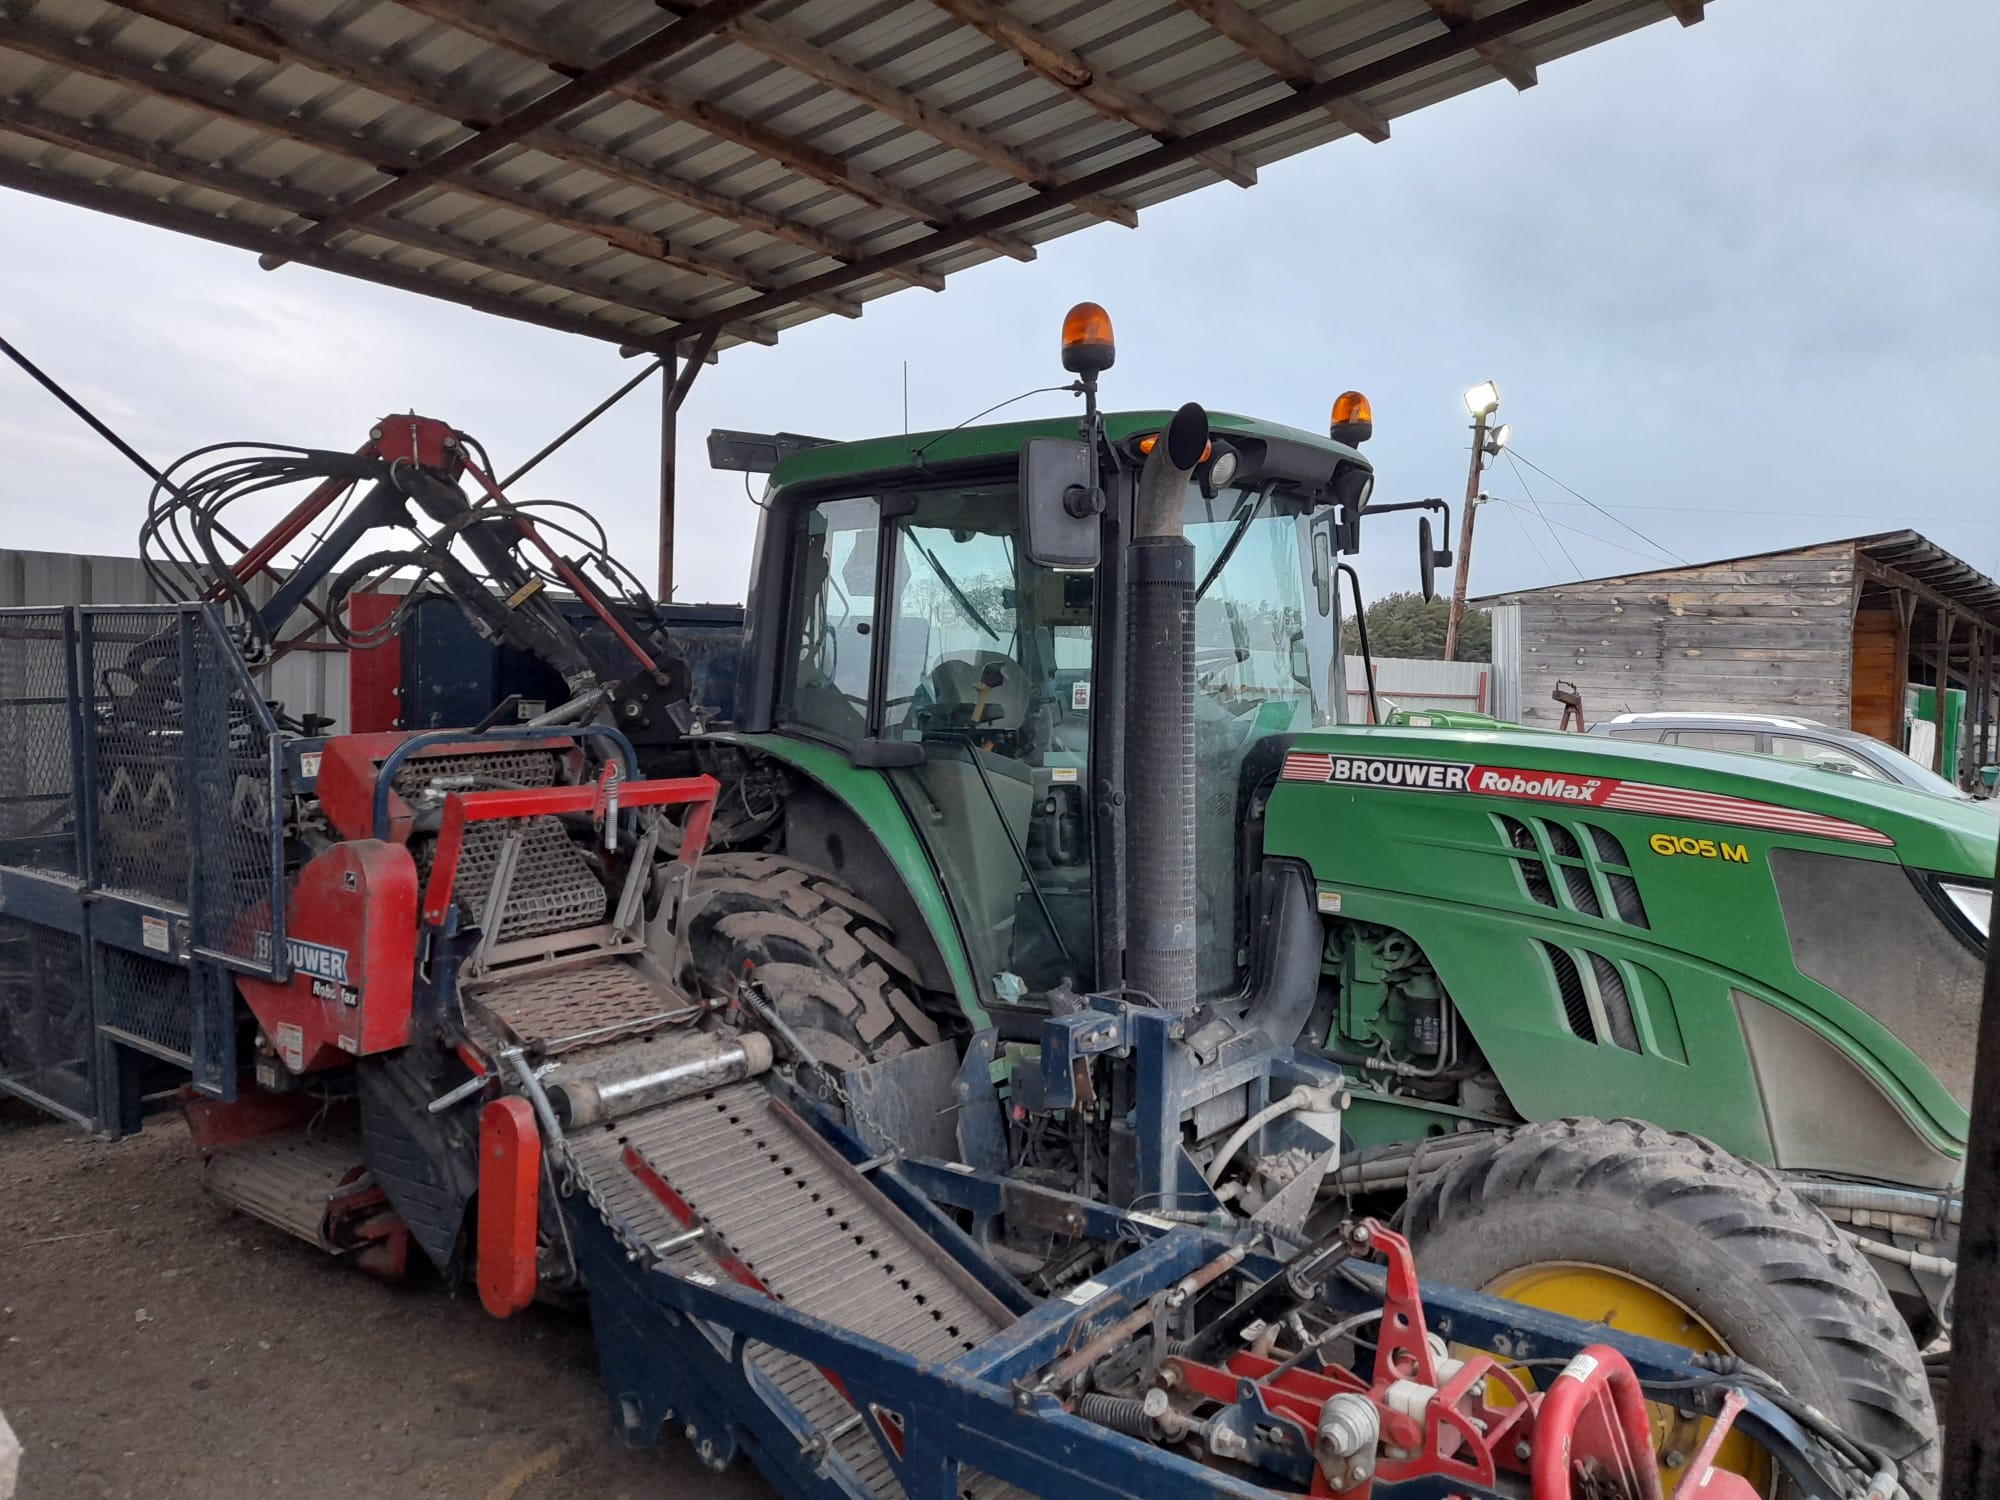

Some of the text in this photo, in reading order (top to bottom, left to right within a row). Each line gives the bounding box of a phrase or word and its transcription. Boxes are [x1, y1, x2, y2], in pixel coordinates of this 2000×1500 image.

[1335, 759, 1465, 789] BROUWER
[1479, 771, 1597, 801] RoboMax
[1648, 833, 1749, 864] 6105 M
[258, 935, 343, 978] BUWER
